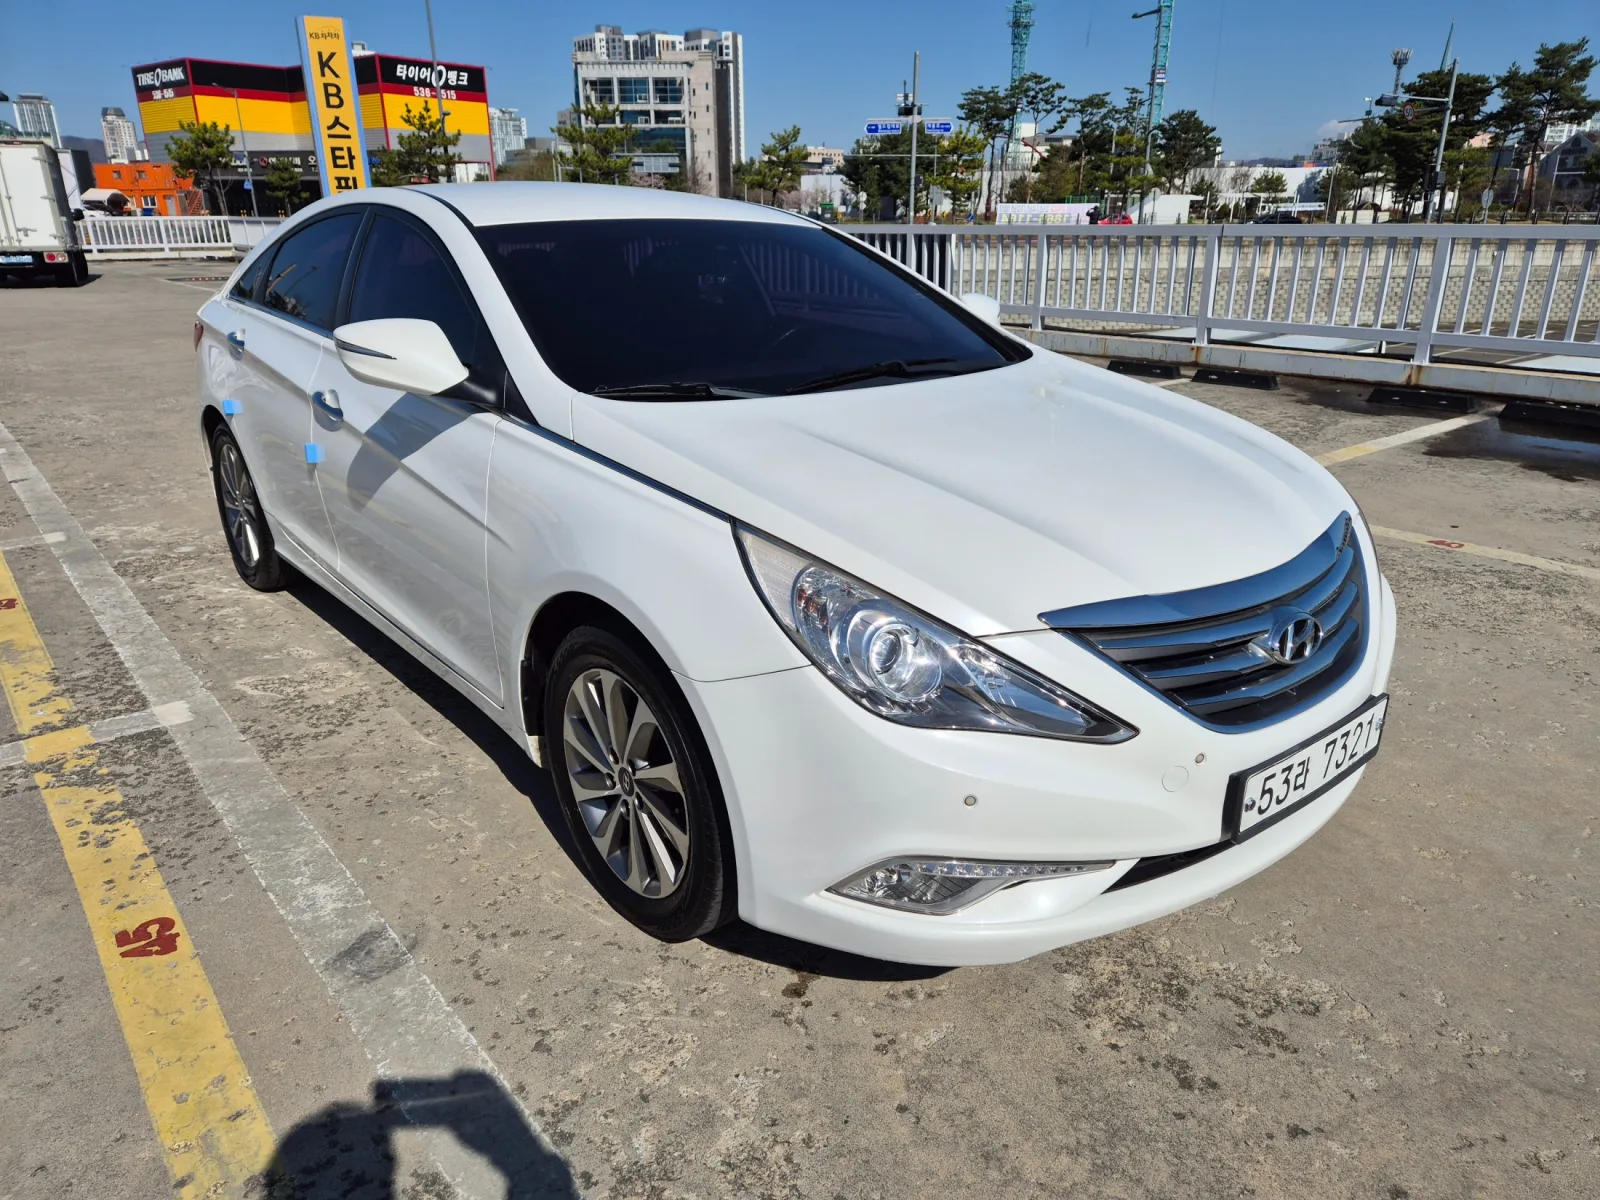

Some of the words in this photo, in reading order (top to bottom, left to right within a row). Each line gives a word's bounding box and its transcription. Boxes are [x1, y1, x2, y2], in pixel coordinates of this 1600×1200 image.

[413, 86, 457, 100] 536-515
[1257, 756, 1310, 816] 53라
[1322, 712, 1375, 779] 7321
